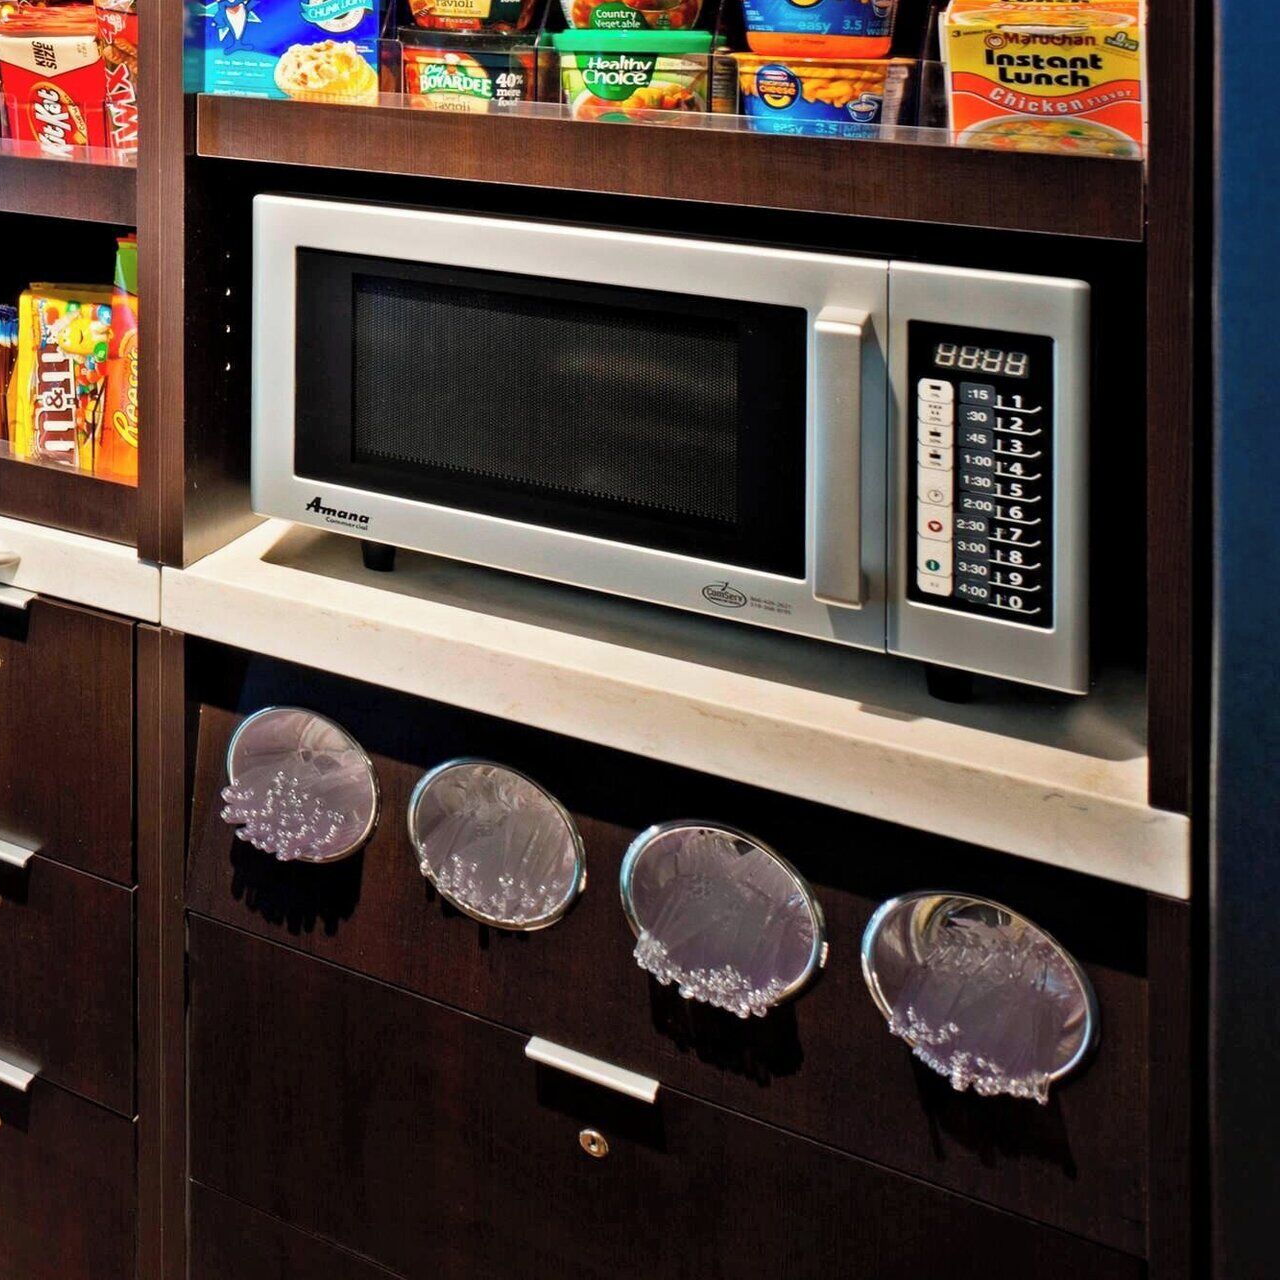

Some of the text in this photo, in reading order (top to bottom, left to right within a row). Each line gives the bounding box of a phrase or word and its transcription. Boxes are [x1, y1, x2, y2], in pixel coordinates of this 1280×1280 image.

[595, 8, 637, 21] Country
[842, 19, 862, 31] 3.5
[797, 20, 832, 34] easy
[1002, 31, 1096, 47] Maruchan
[32, 40, 43, 68] KING
[44, 42, 58, 70] SIZE
[587, 54, 653, 72] Healthy
[984, 49, 1103, 71] Instant
[420, 70, 493, 97] BOYARDEE
[581, 68, 650, 86] Choice
[997, 66, 1090, 88] Lunch
[989, 86, 1084, 112] Chicken
[968, 389, 1022, 408] :15 1
[967, 411, 1023, 430] :30 2
[966, 434, 1023, 452] :45 3
[964, 455, 1023, 475] 1:00 4
[963, 475, 1023, 497] 1:30 5
[305, 496, 370, 524] Amana
[963, 499, 1023, 519] 2:00 6
[325, 516, 369, 531] Commercial
[957, 519, 1023, 541] 2:30 7
[957, 541, 1023, 564] 3:00 8
[958, 563, 1023, 585] 3:30 9
[958, 585, 1023, 610] 4:00 0
